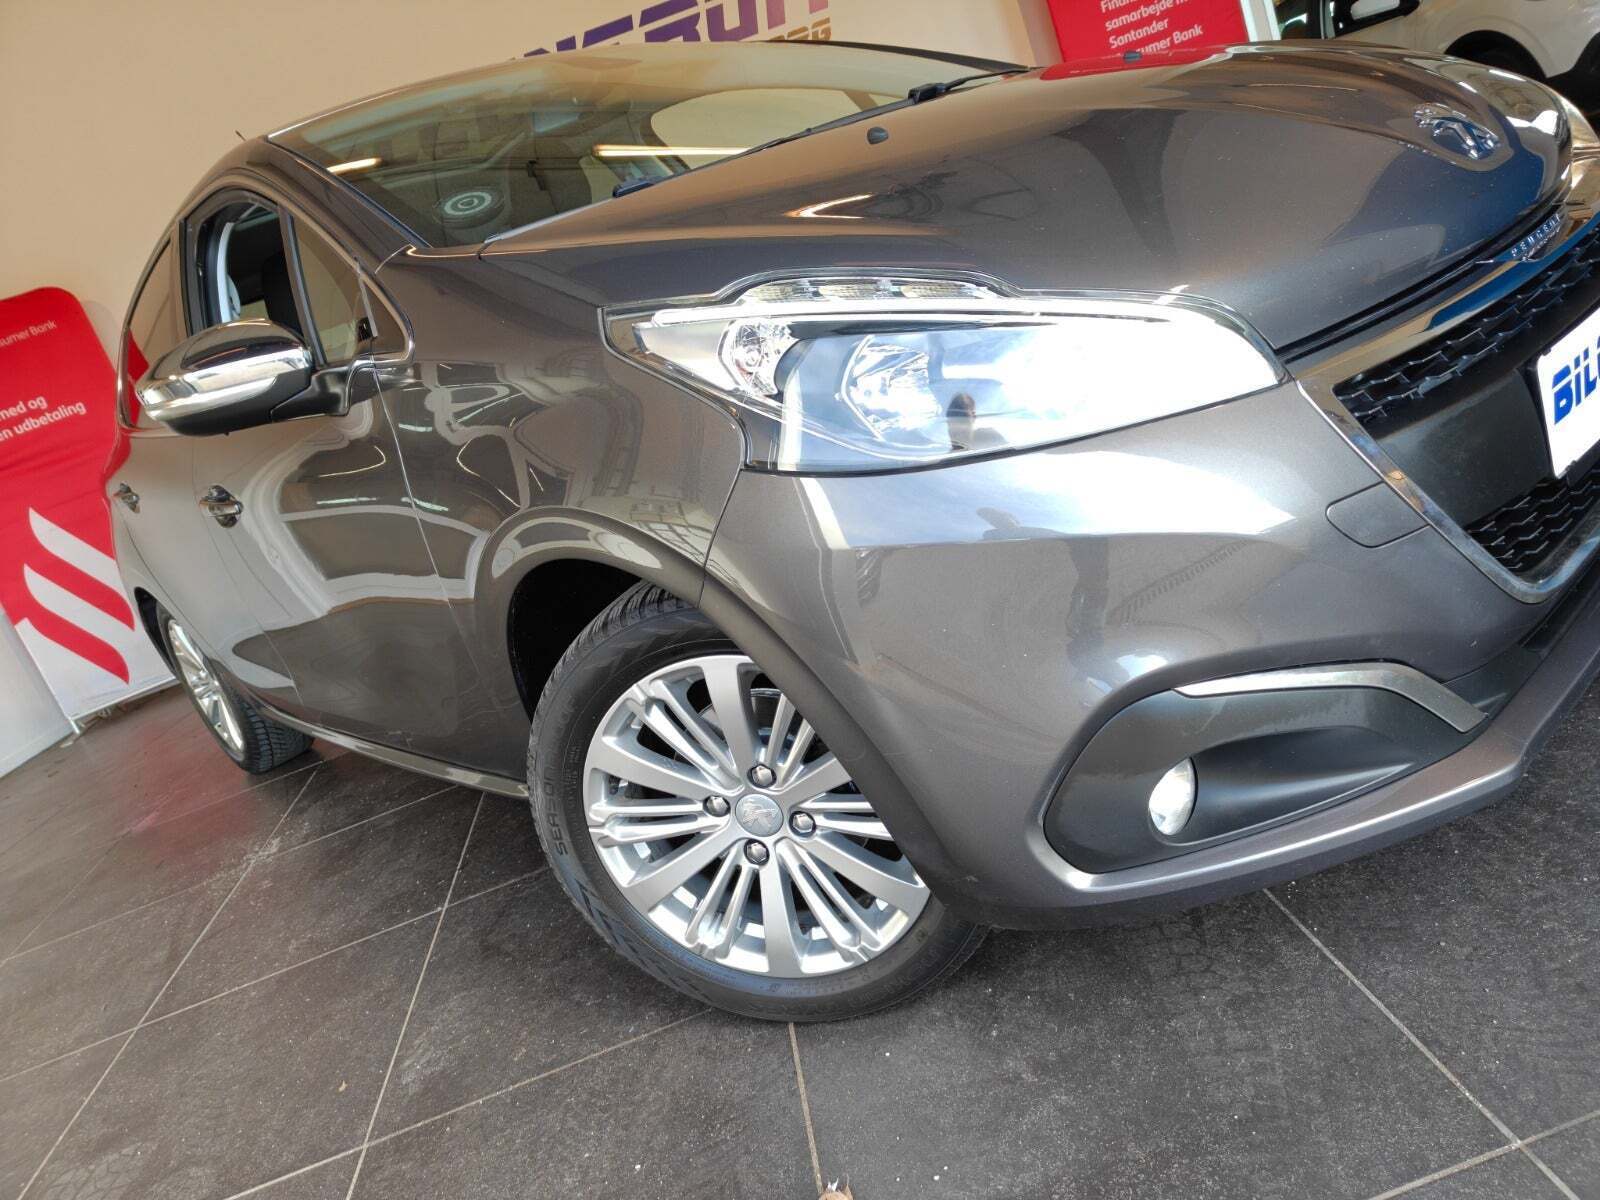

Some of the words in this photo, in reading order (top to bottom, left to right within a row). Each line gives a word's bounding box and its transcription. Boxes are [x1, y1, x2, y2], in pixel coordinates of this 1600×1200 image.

[1105, 0, 1174, 31] samarbejde
[1109, 19, 1169, 49] Santander
[1136, 36, 1171, 53] umer
[1172, 24, 1203, 44] Bank
[29, 319, 57, 336] Bank
[1552, 336, 1600, 425] BIL
[28, 395, 48, 410] og
[13, 402, 87, 434] udbetaling
